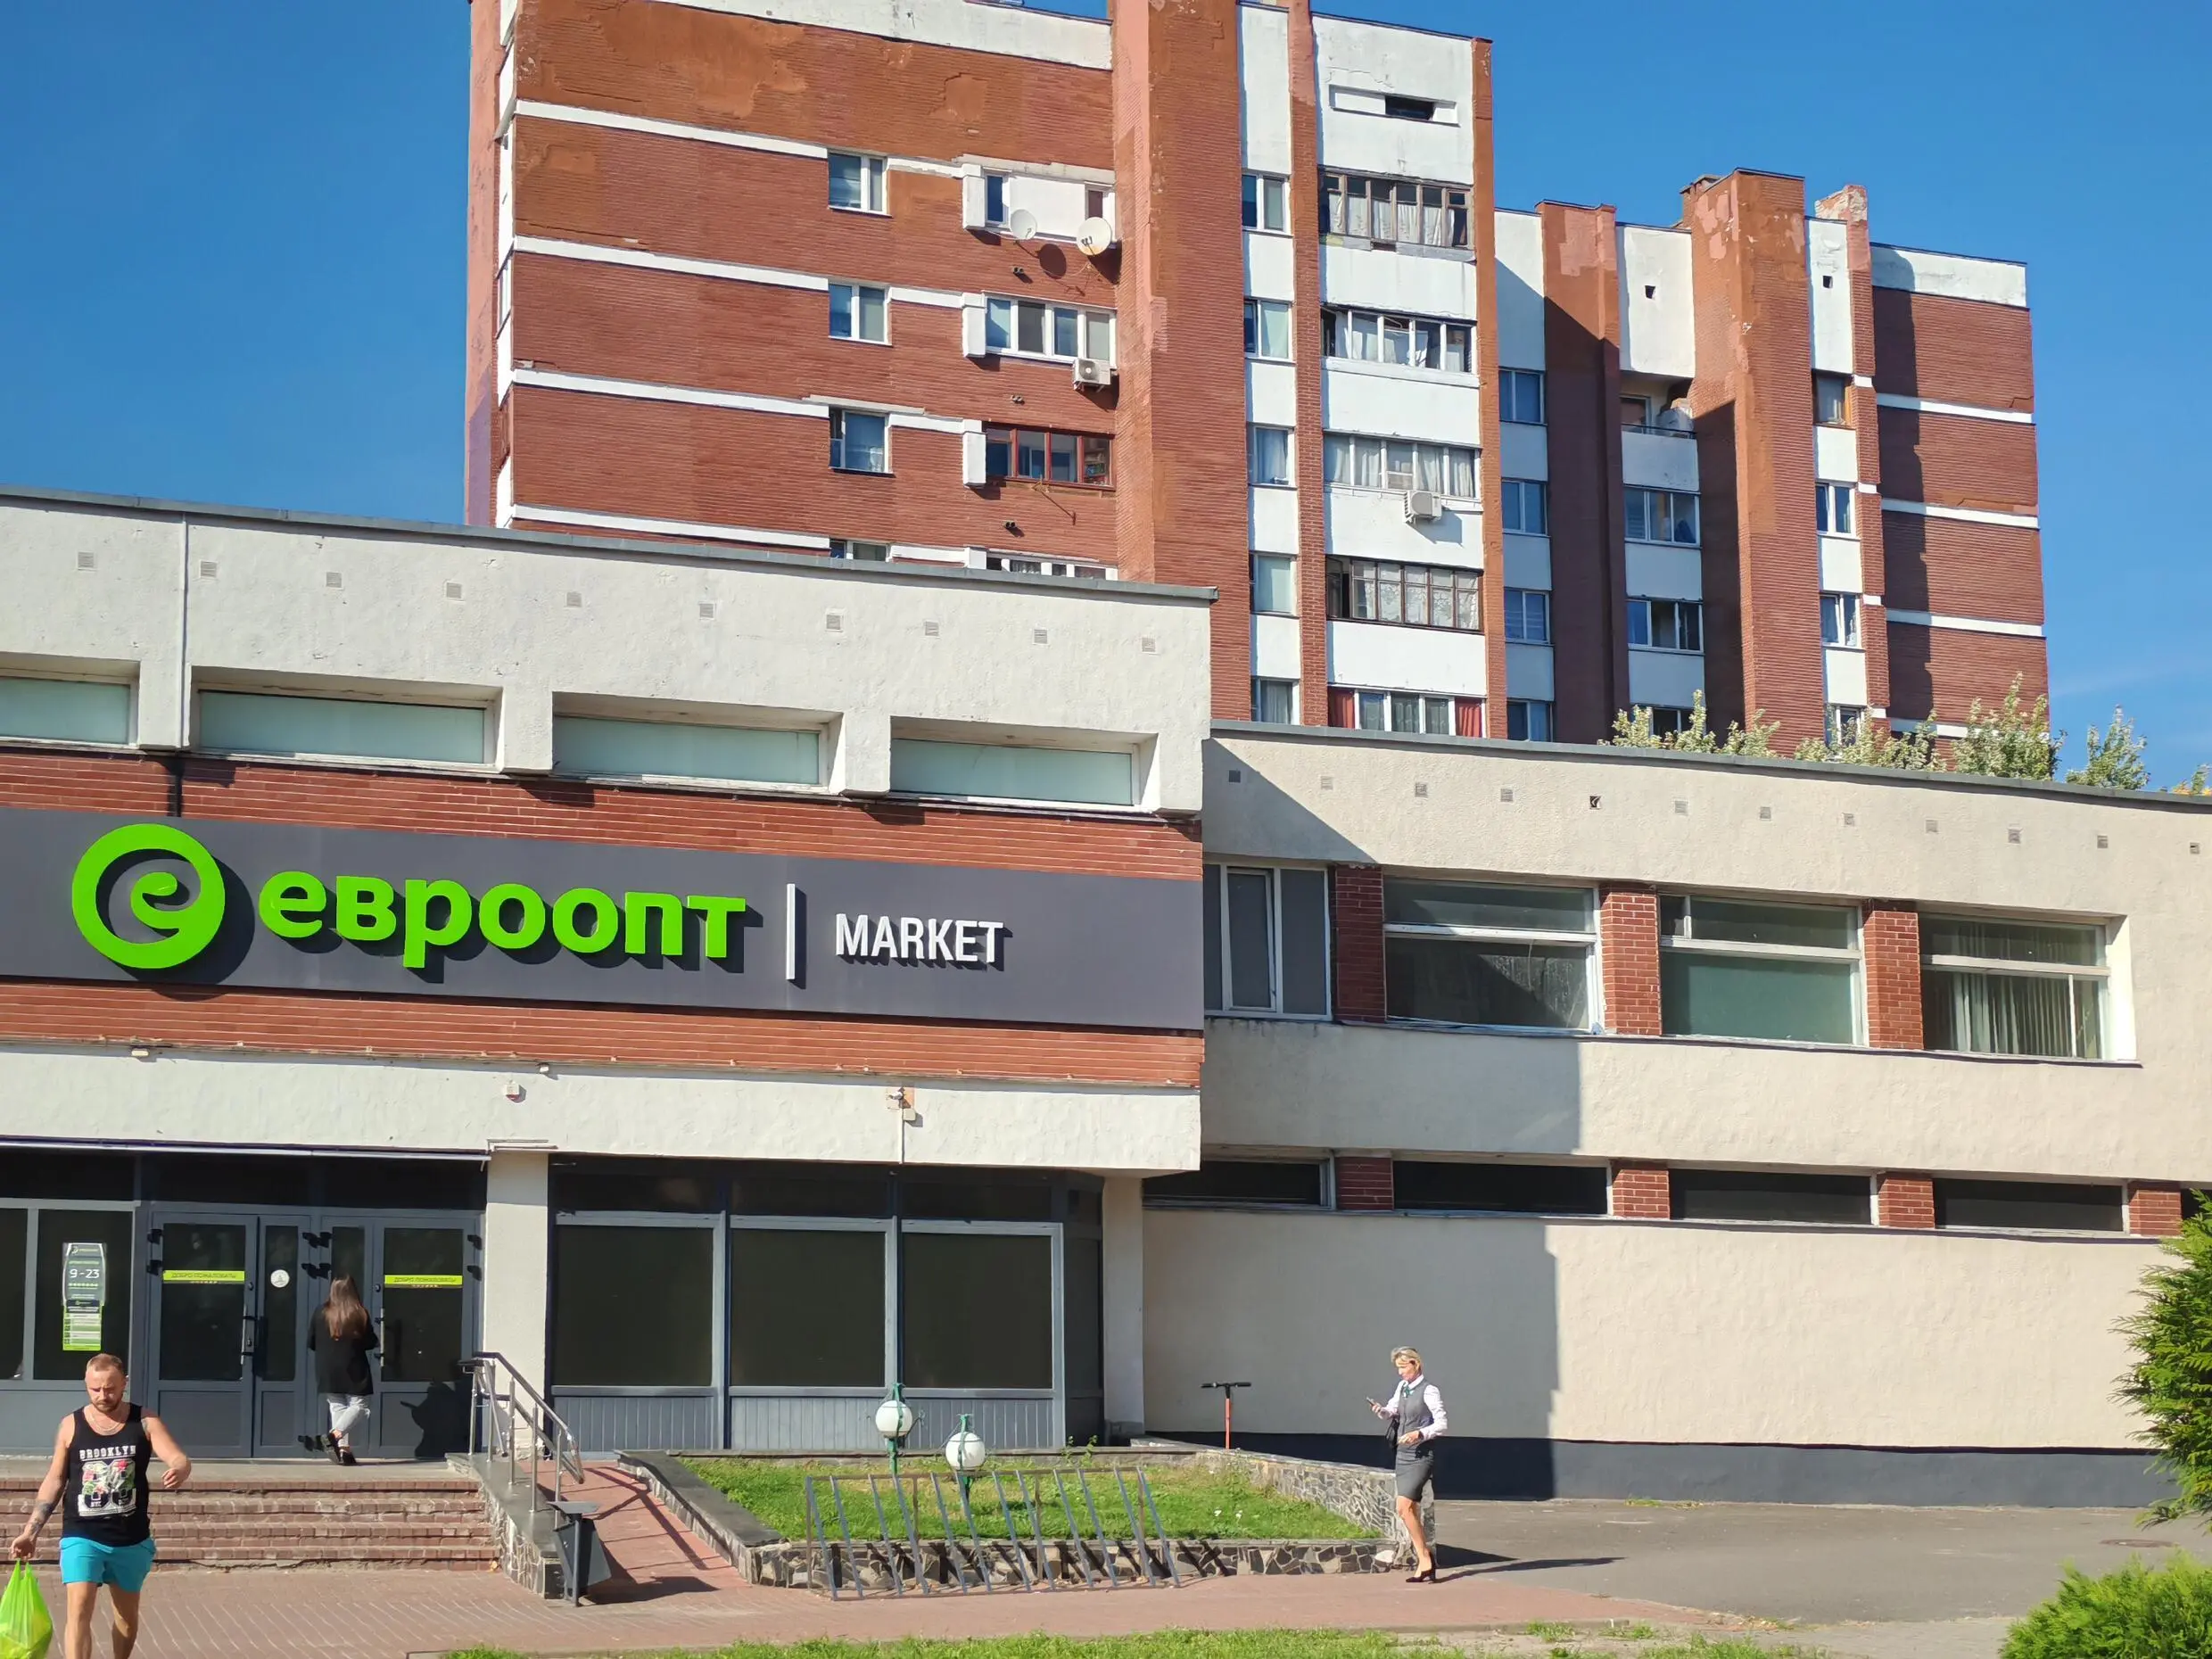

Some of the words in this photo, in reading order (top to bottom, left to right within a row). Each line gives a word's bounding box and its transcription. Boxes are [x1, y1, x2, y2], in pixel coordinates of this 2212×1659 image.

[259, 871, 746, 968] евроопт
[836, 913, 1003, 962] MARKET
[79, 1445, 136, 1460] BROOKLYN
